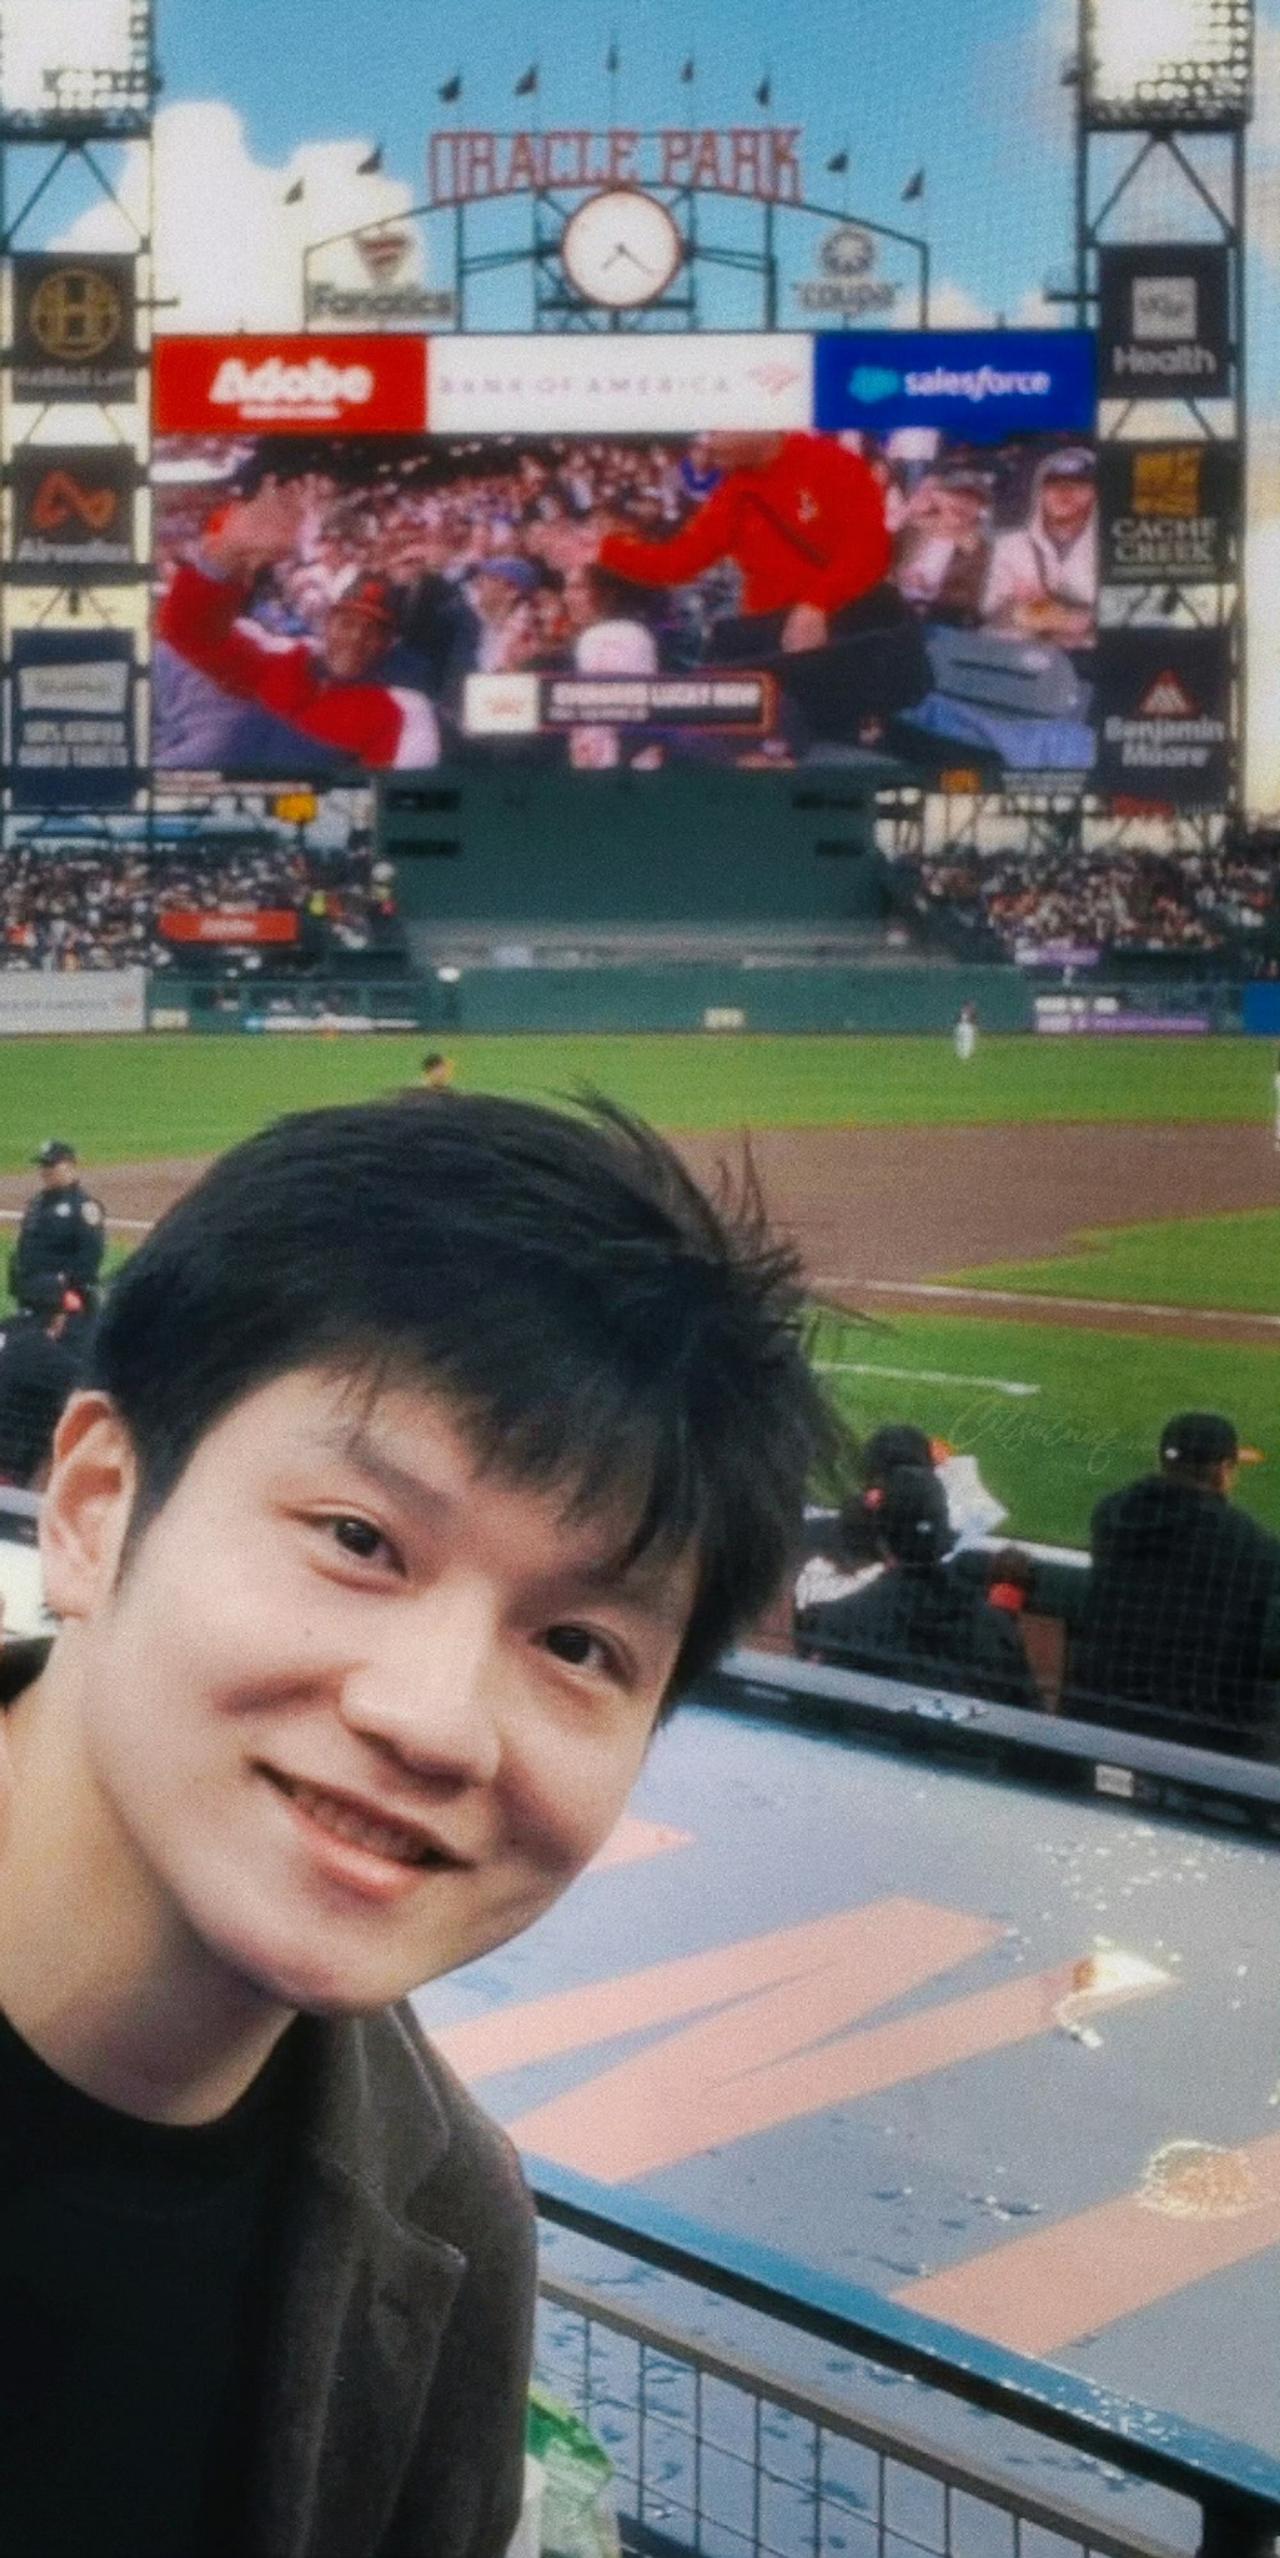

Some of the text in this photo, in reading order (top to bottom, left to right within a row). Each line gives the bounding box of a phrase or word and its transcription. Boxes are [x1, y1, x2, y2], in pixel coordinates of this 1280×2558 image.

[429, 127, 802, 206] ORACLE PARK
[309, 280, 454, 319] Fanatics
[1113, 343, 1218, 376] Health
[208, 356, 375, 405] Adobe
[438, 375, 729, 394] BANK OF AMERICA
[904, 364, 1052, 403] salesforce
[1111, 517, 1218, 542] CACHE
[1113, 541, 1215, 562] CREEK
[1104, 714, 1226, 746] Benjamin
[1121, 742, 1208, 768] Moore
